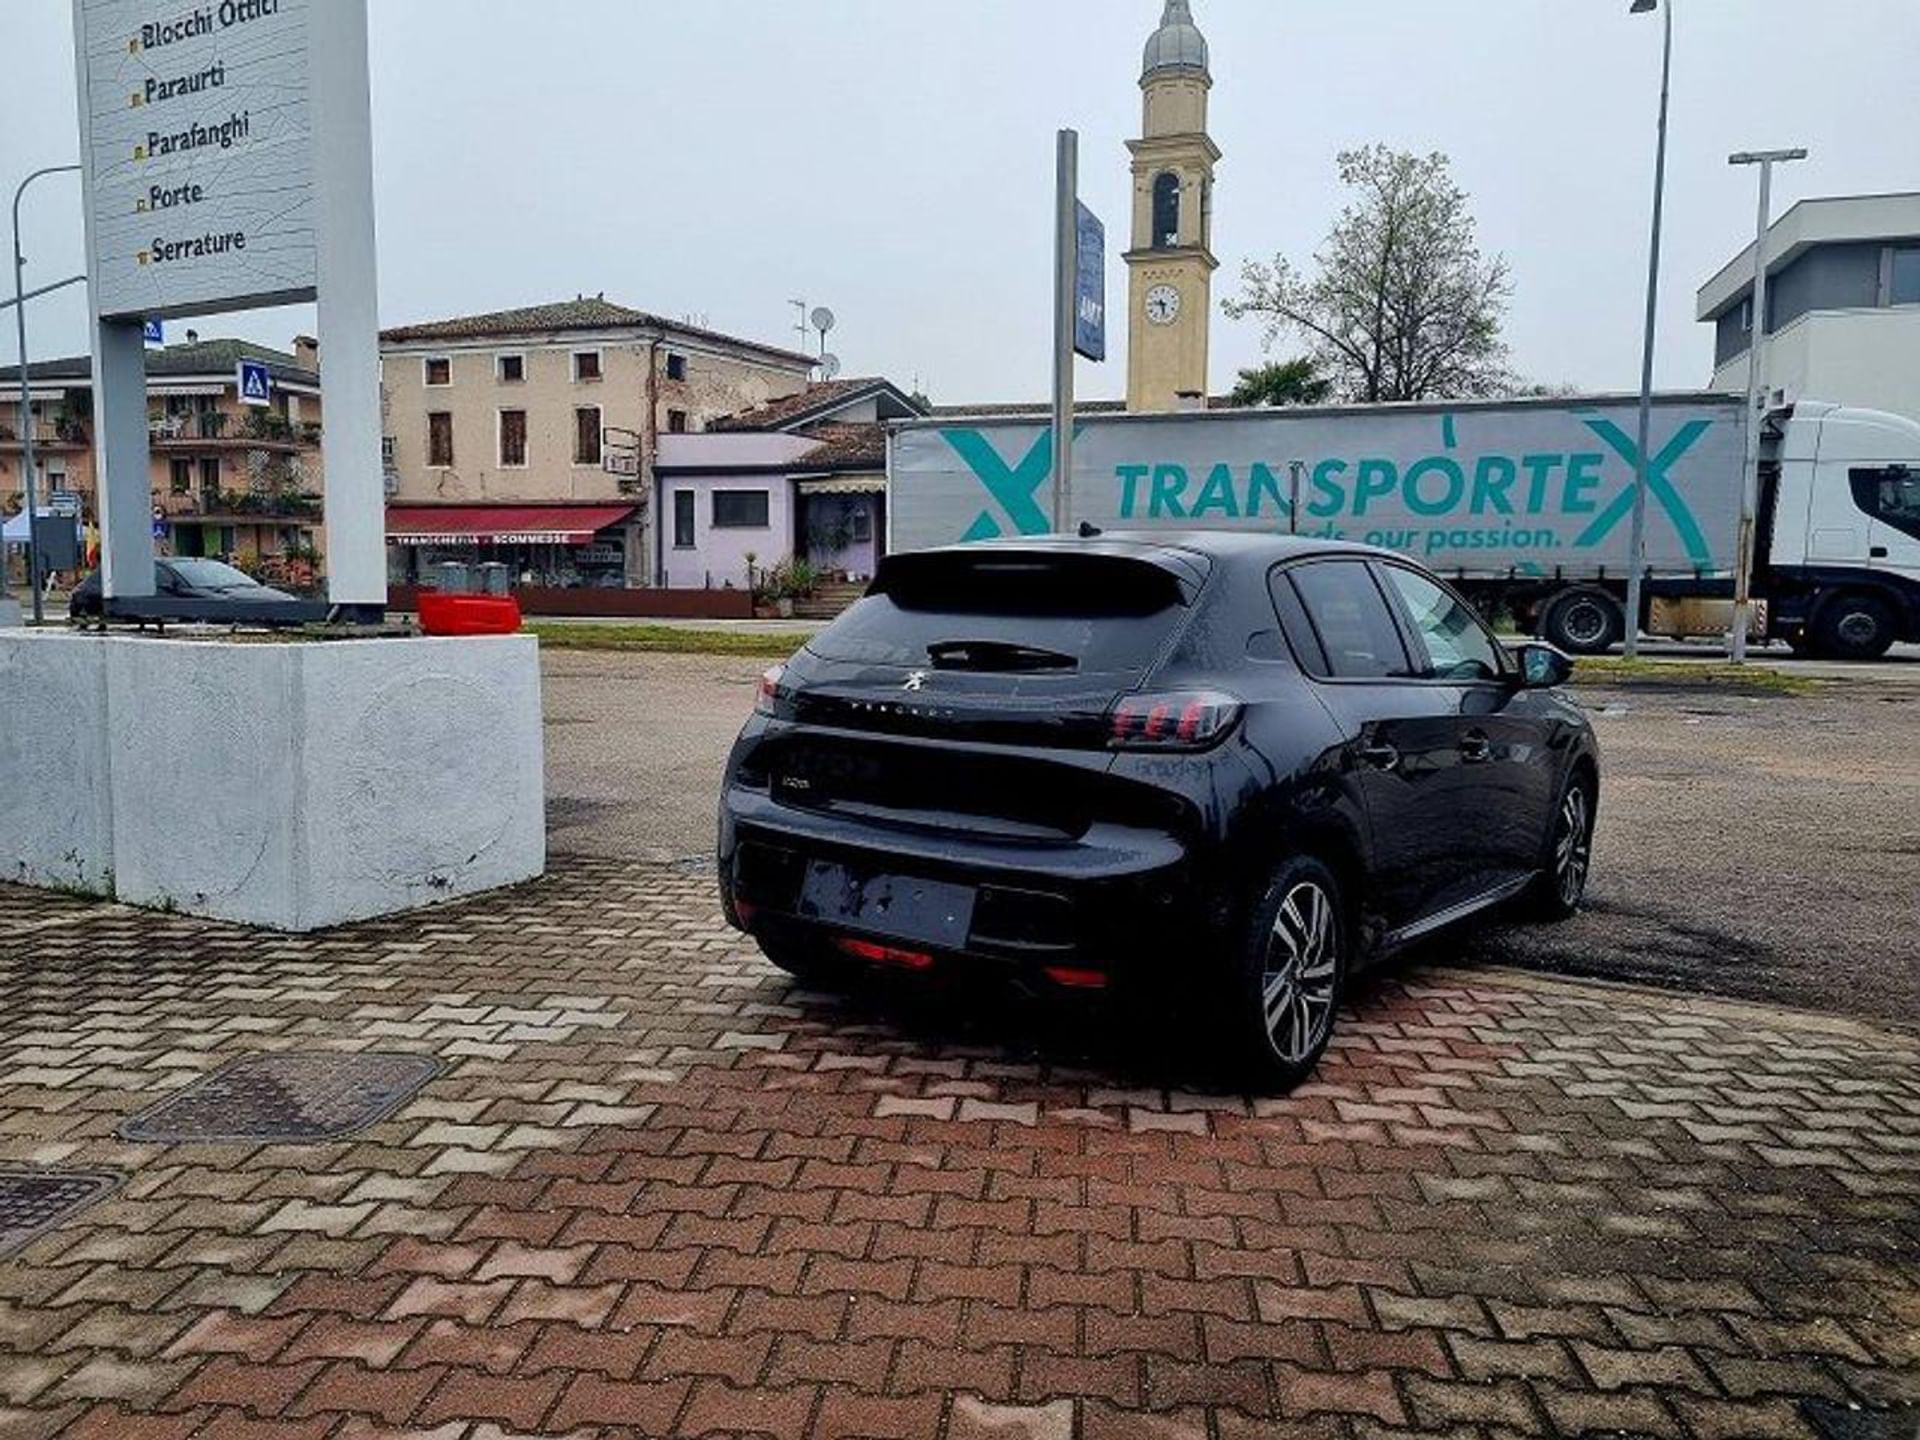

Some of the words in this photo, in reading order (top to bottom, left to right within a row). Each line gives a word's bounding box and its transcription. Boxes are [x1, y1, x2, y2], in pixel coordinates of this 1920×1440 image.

[141, 6, 213, 49] Blocchi
[145, 60, 226, 104] Paraurti
[147, 110, 250, 157] Parafanghi
[150, 182, 203, 210] Porte
[151, 230, 246, 262] Serrature
[1115, 420, 1714, 574] TRANSPORTEX
[1364, 528, 1420, 550] our
[1424, 519, 1562, 556] passion.
